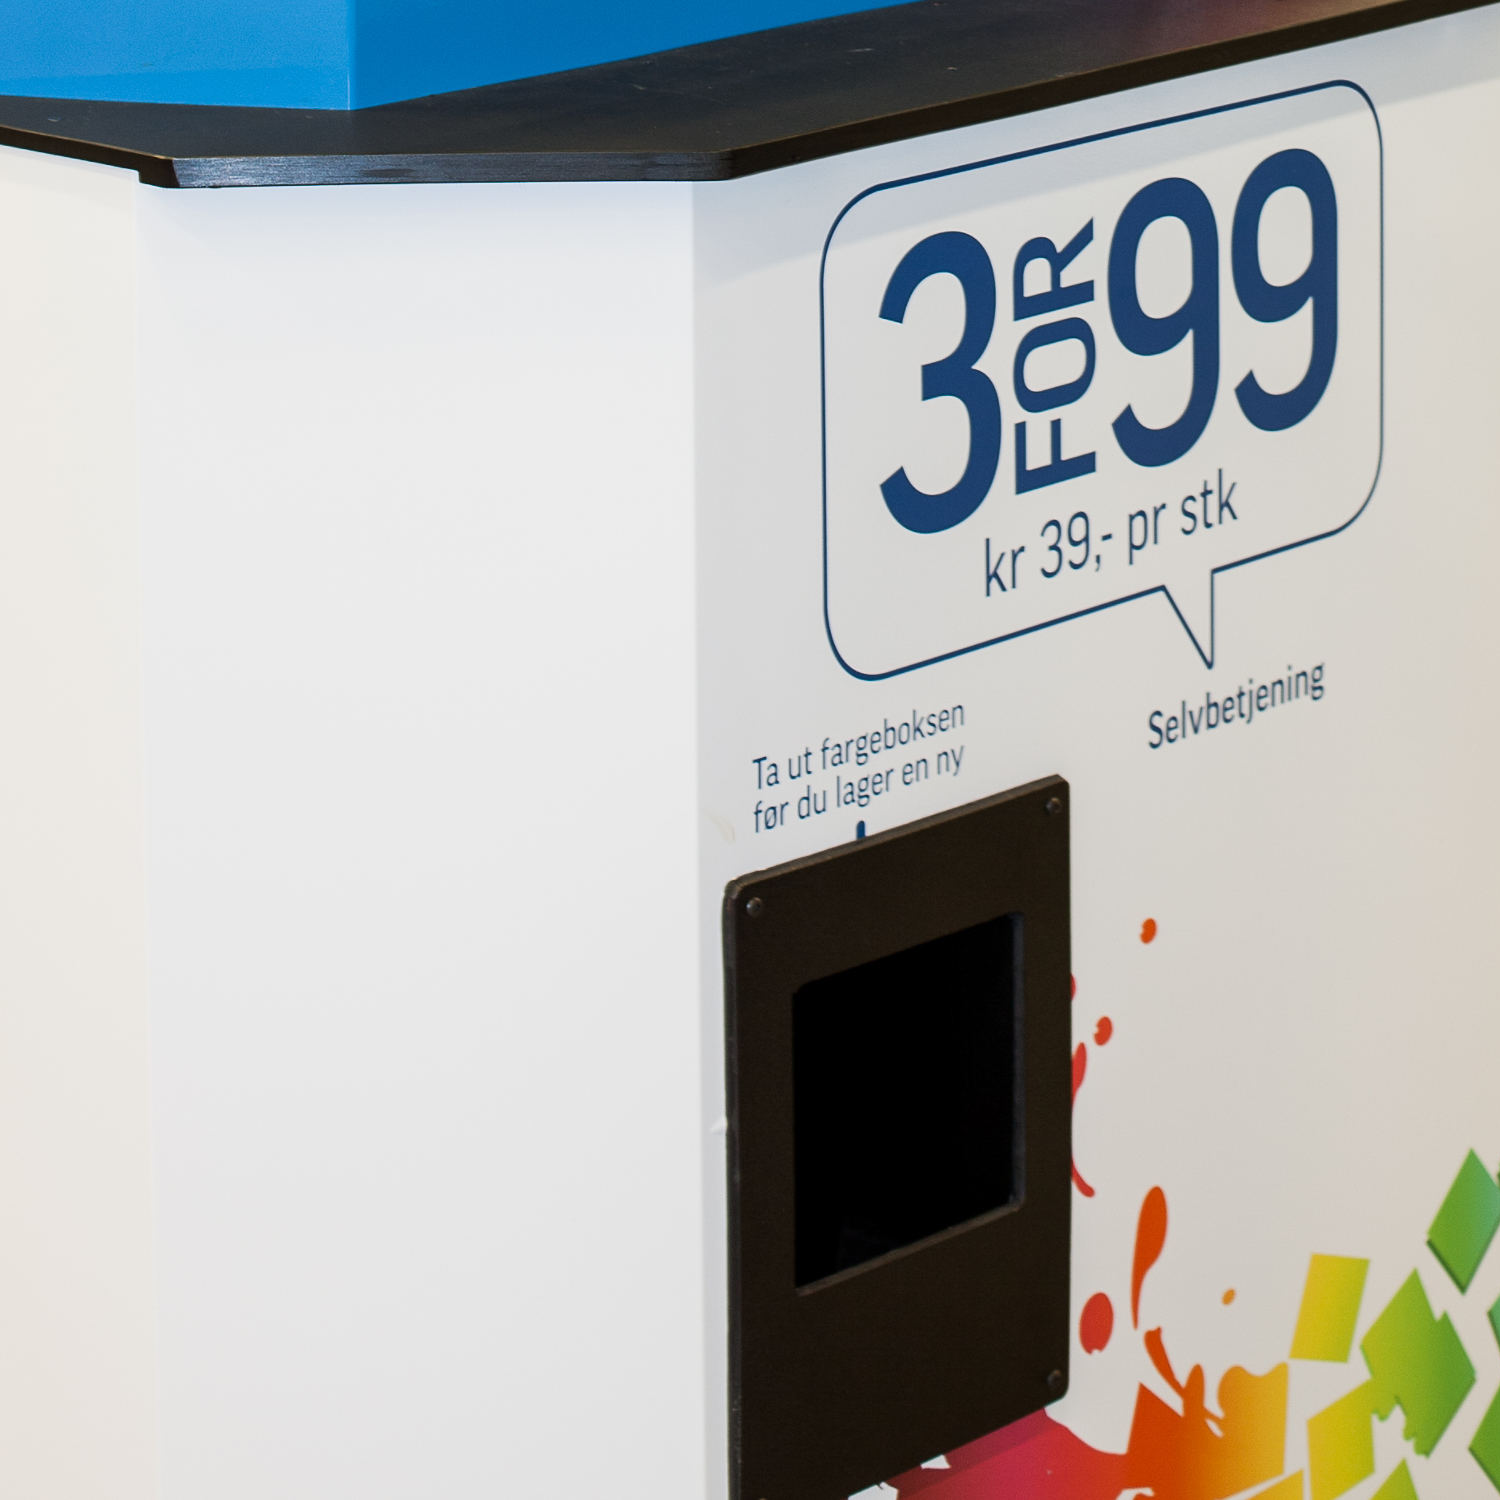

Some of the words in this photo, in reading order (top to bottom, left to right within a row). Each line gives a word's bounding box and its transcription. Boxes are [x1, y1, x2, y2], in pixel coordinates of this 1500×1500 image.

[878, 229, 1002, 535] 3
[1012, 216, 1097, 496] FOR
[1106, 147, 1339, 468] 99
[983, 537, 1027, 599] kr
[1038, 508, 1113, 580] 39,-
[1127, 500, 1168, 565] pr
[1179, 467, 1240, 536] stk
[752, 756, 780, 790] Ta
[788, 746, 812, 780] ut
[821, 704, 965, 767] fargeboksen
[1147, 661, 1326, 752] Selvbetjening
[754, 801, 789, 833] før
[798, 785, 827, 820] du
[836, 768, 894, 808] lager
[902, 756, 928, 786] en
[937, 744, 965, 777] ny
